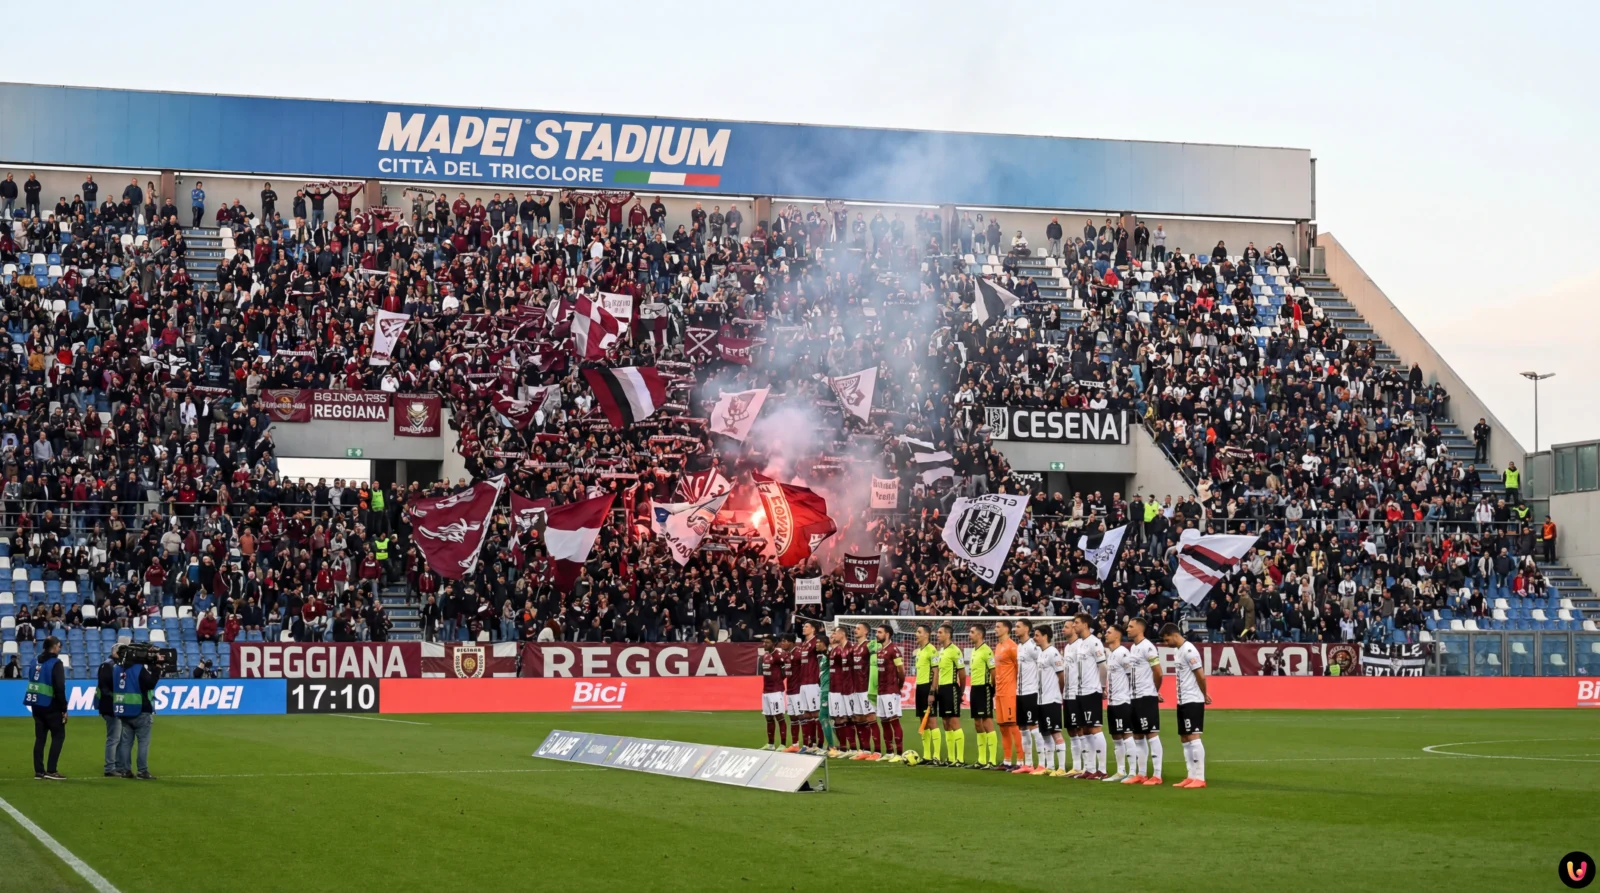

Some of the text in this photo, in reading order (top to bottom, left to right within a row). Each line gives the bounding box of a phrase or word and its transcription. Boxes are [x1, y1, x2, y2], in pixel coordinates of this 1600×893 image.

[530, 119, 732, 167] STADIUM
[377, 156, 604, 183] CITTÀ DEL TRICOLORE
[314, 404, 386, 419] REGGIANA
[1013, 410, 1120, 441] CESENA
[240, 645, 408, 678] REGGIANA
[541, 646, 728, 677] REGGA
[155, 685, 244, 710] STAPEI
[292, 684, 375, 710] 17:10
